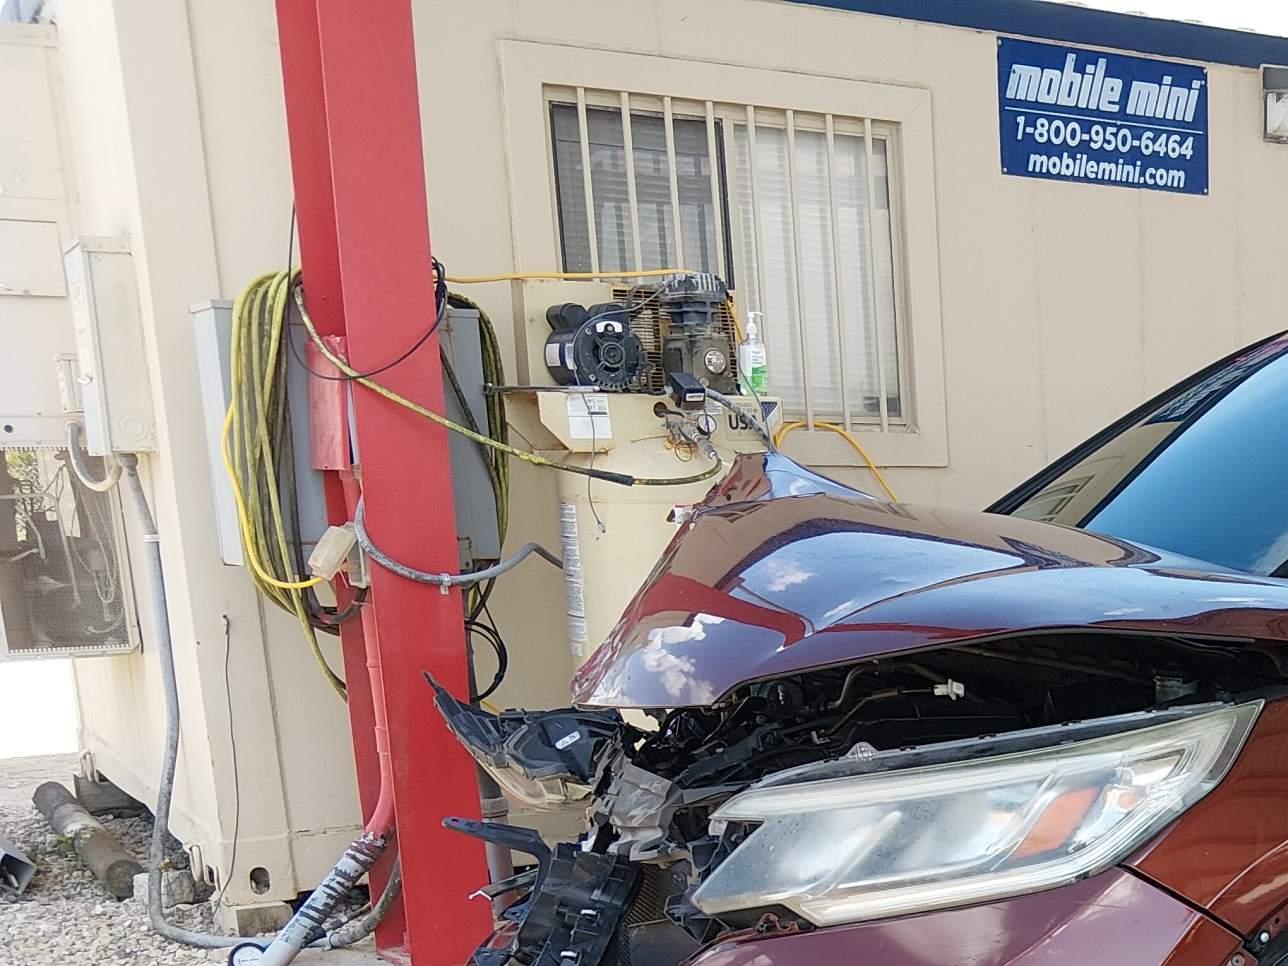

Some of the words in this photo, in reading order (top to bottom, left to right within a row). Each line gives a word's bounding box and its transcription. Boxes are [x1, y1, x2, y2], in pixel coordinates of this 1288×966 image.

[1005, 53, 1123, 113] mobile
[1126, 75, 1202, 122] mini
[1015, 115, 1194, 160] 1-800-950-6464
[1027, 152, 1186, 188] mobilemini.com
